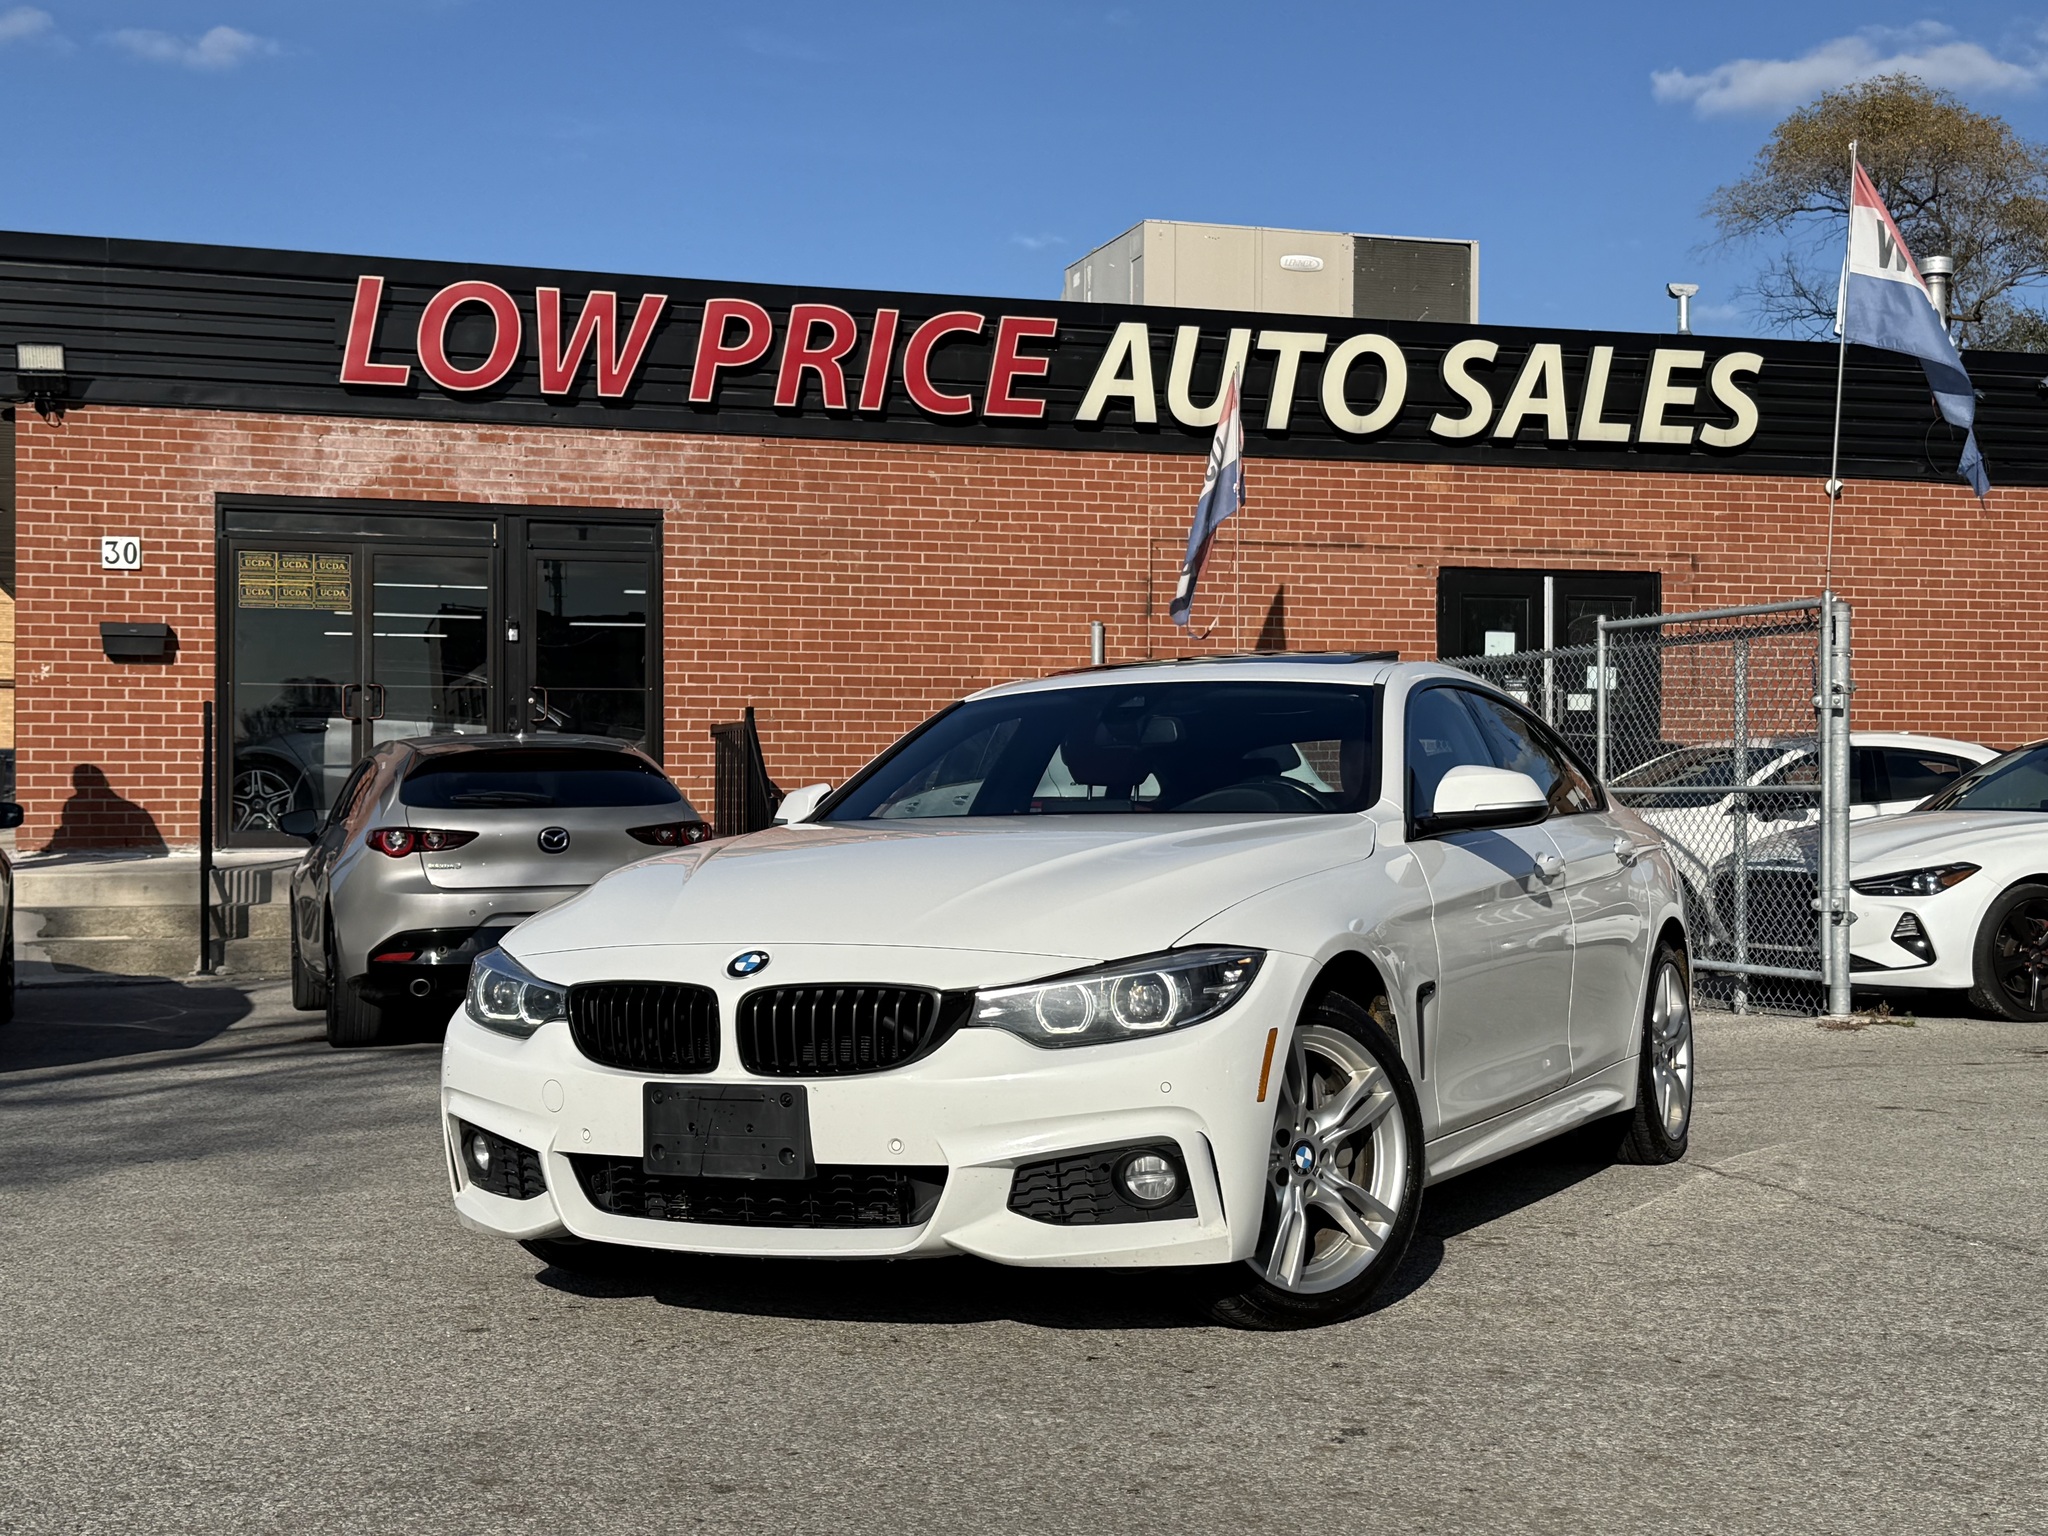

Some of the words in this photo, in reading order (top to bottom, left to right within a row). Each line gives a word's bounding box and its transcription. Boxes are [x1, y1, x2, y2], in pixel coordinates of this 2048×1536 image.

[340, 275, 668, 398] LOW
[688, 297, 1059, 420] PRICE
[1075, 322, 1408, 435] AUTO
[1430, 339, 1764, 448] SALES
[104, 540, 138, 565] 30
[244, 559, 272, 568] UCDA
[282, 561, 309, 570] UCDA
[319, 563, 346, 571] UCDA
[245, 588, 271, 597] UCDA
[282, 589, 309, 598] UCDA
[320, 589, 347, 598] UCDA
